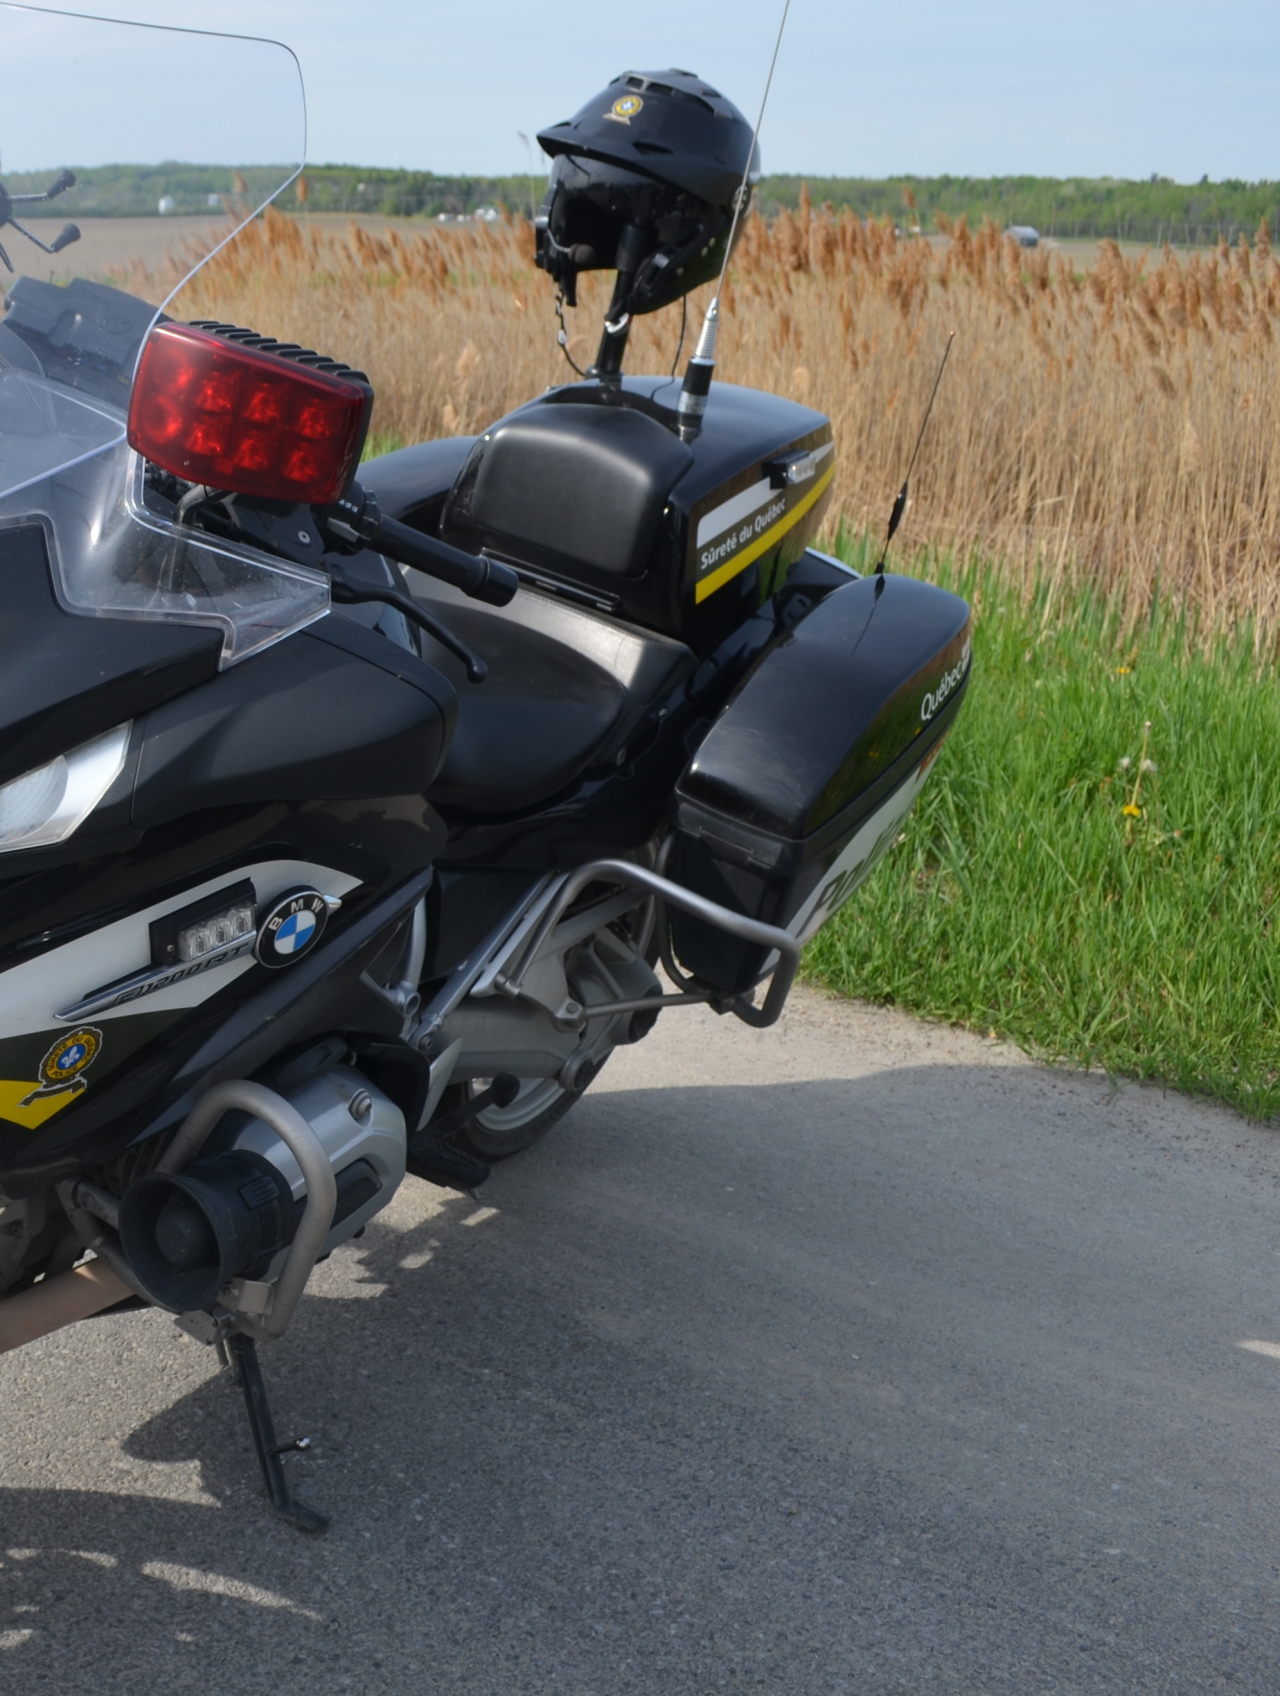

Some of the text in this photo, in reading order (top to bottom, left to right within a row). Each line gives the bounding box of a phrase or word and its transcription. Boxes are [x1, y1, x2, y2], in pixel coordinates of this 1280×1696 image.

[701, 498, 787, 570] Sûreté du Québec
[921, 661, 962, 720] Québec
[268, 898, 324, 931] BMW
